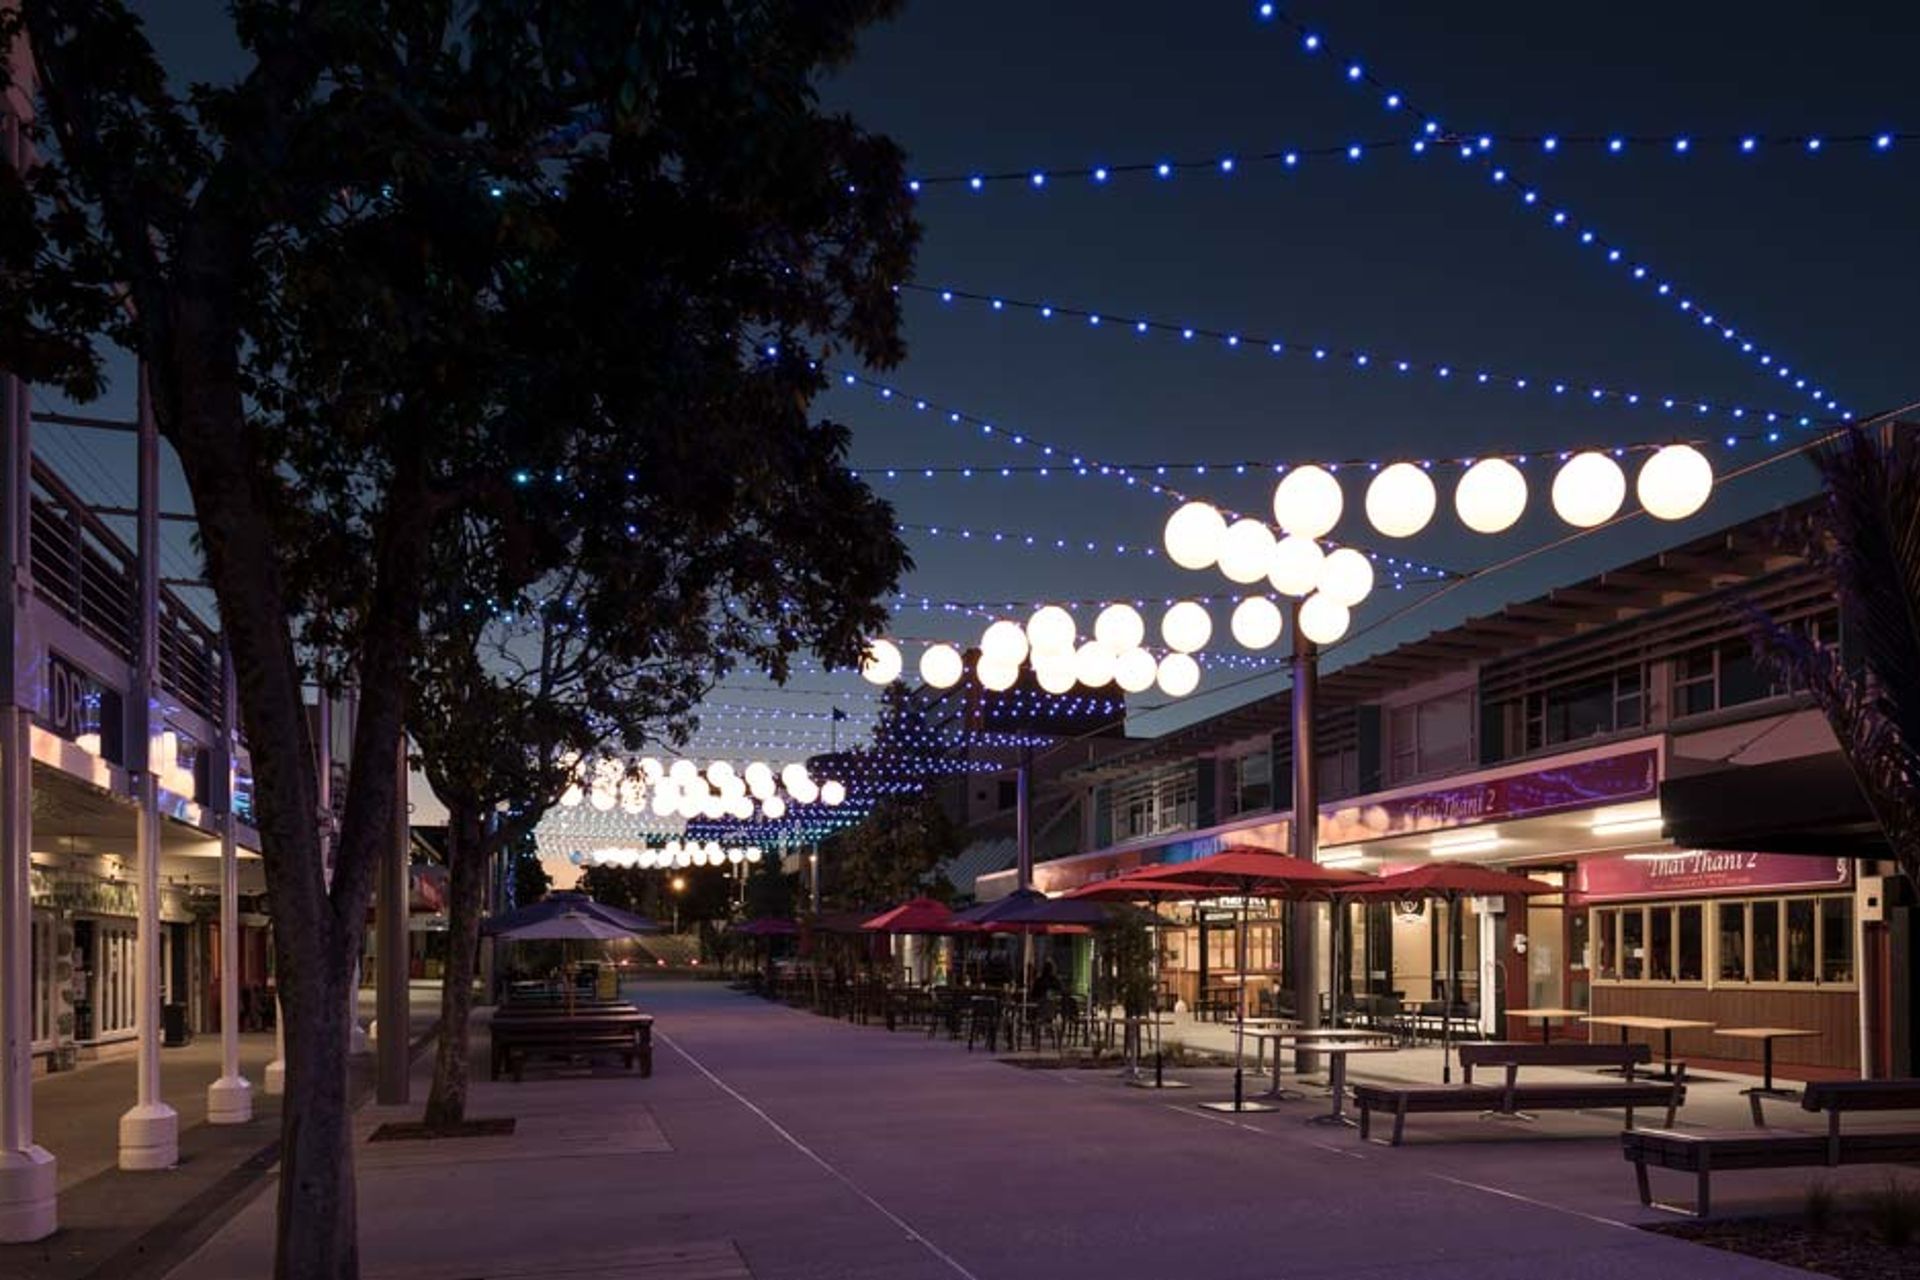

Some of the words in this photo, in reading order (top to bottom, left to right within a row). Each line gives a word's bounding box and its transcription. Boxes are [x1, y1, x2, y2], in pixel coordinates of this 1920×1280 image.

[1486, 788, 1496, 811] 2
[1648, 857, 1686, 877] Thai
[1690, 851, 1743, 873] Thani
[1746, 852, 1758, 868] 2
